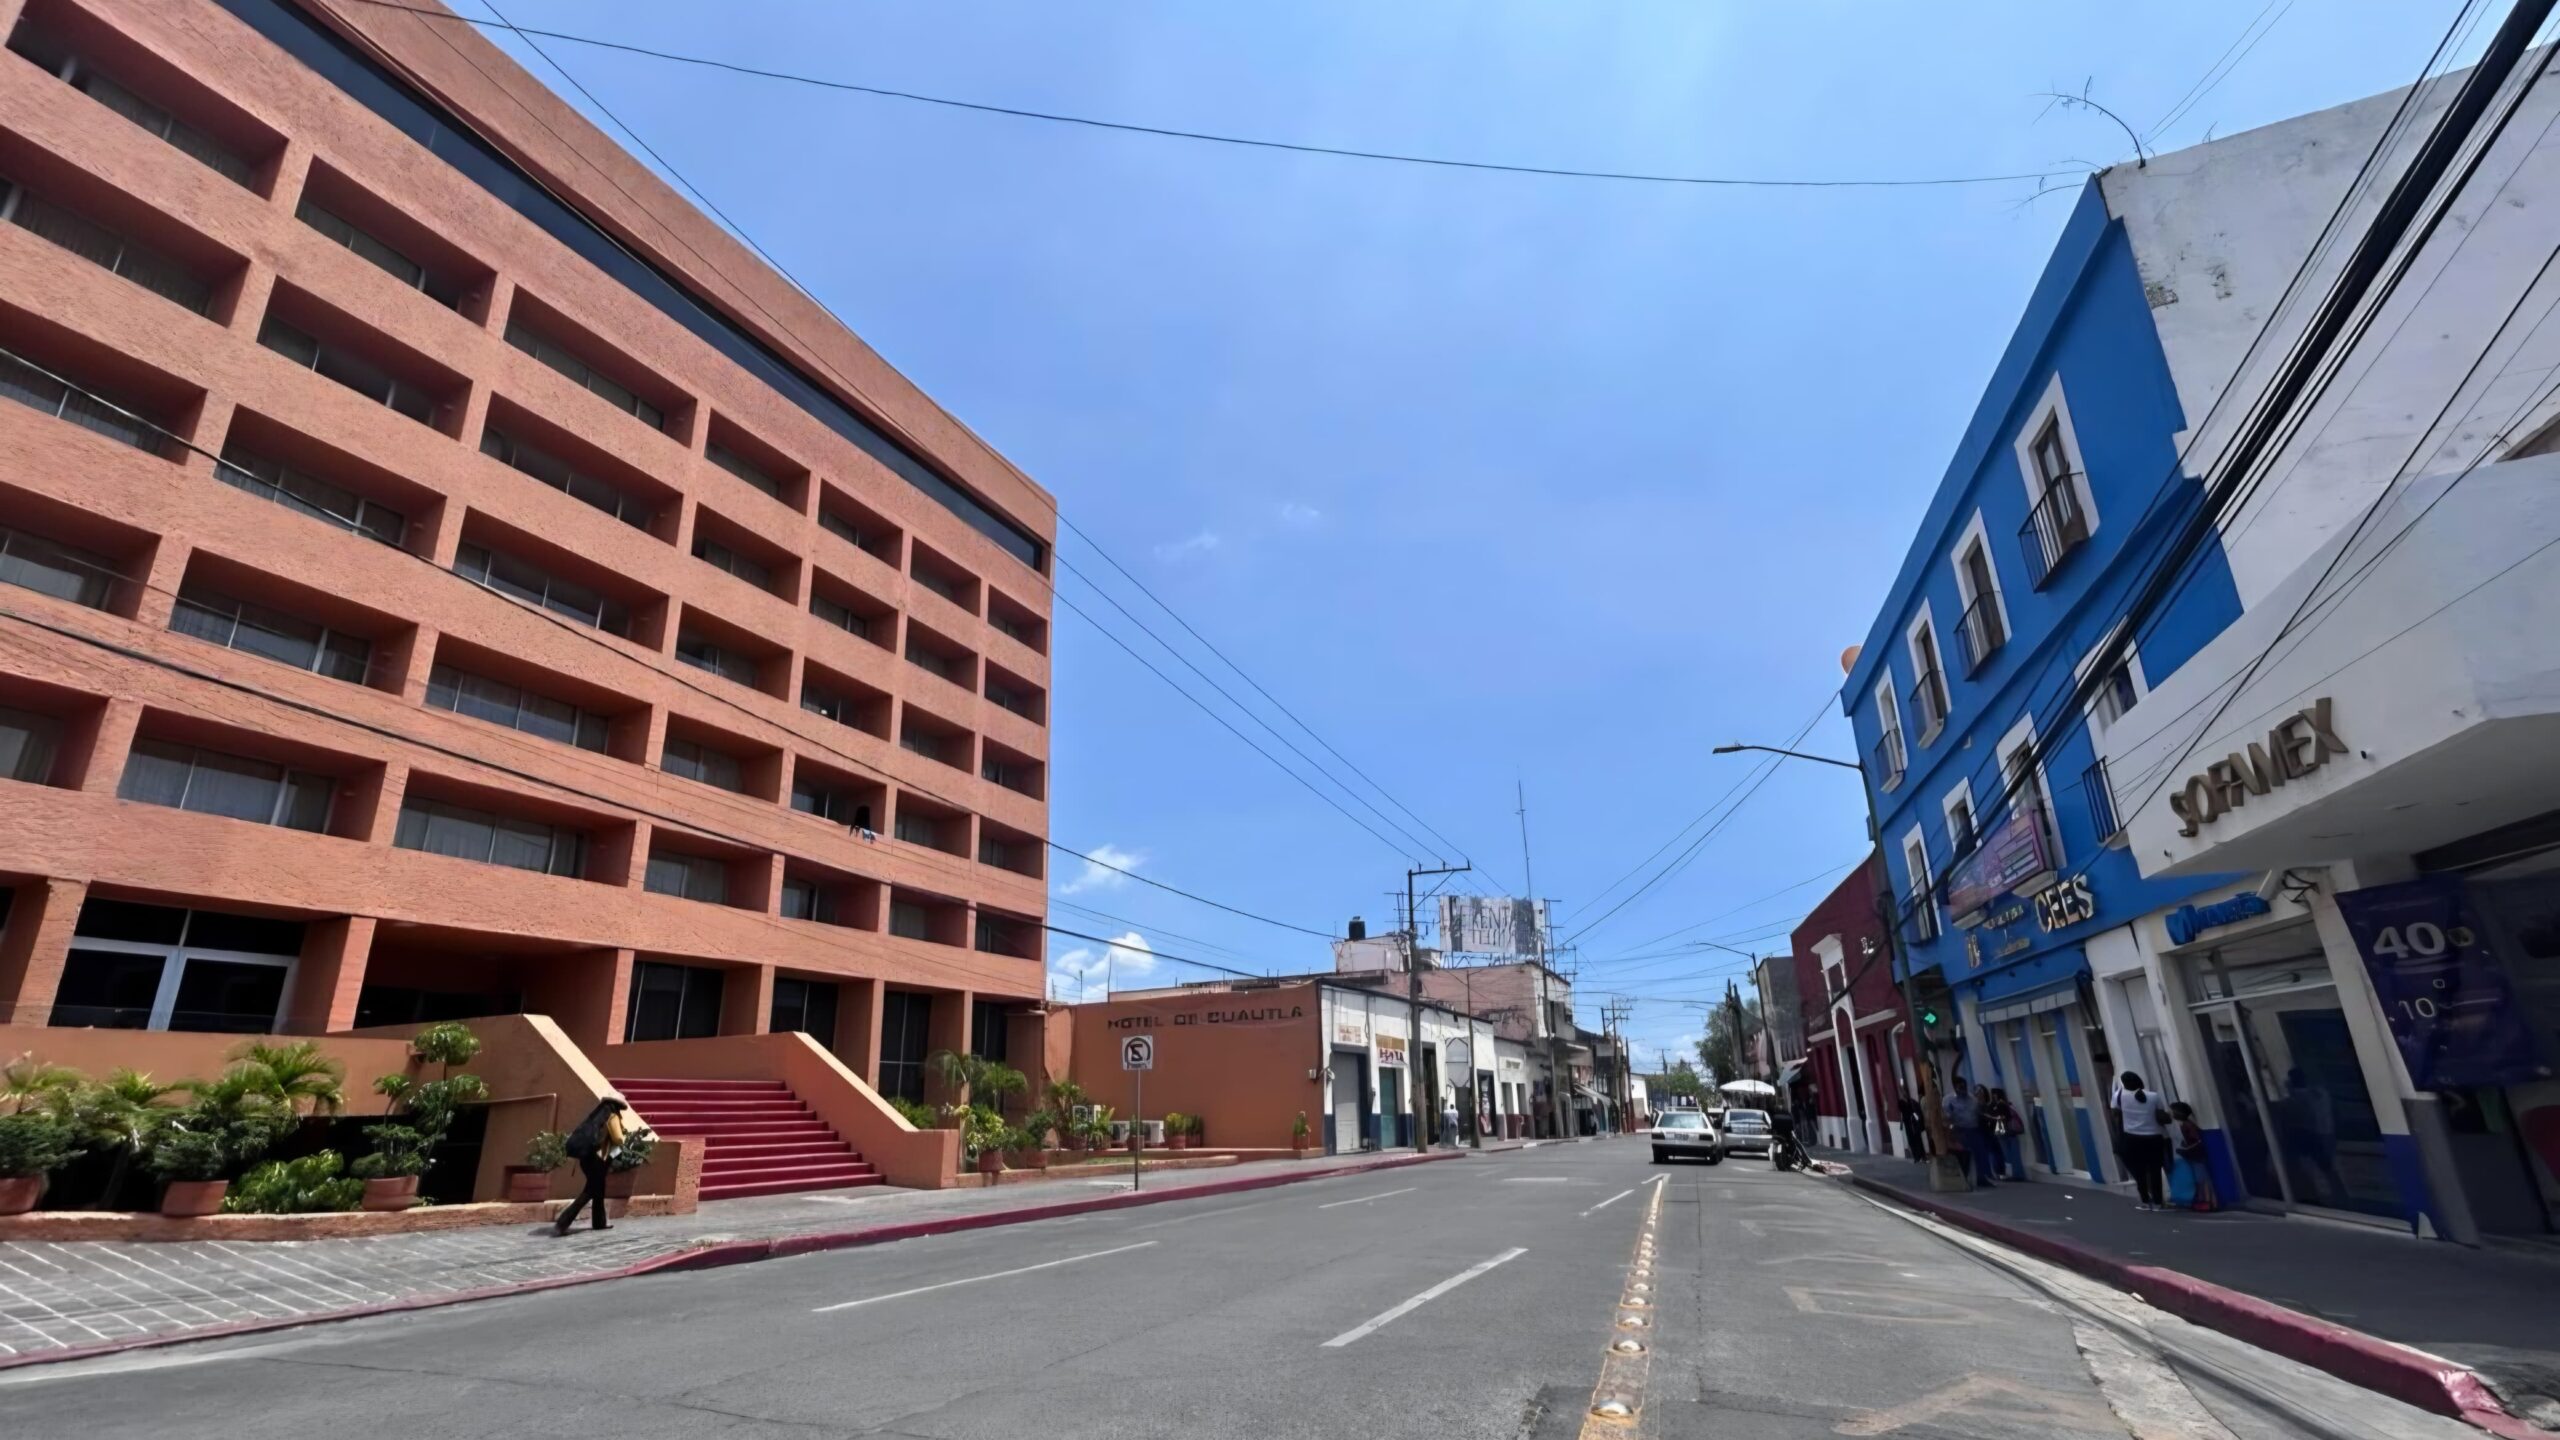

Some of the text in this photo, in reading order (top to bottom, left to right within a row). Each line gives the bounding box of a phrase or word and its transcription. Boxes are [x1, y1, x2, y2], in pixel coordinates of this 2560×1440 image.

[2170, 697, 2349, 837] SOFAMEX
[1107, 1015, 1164, 1030] HOTEL
[1207, 1005, 1303, 1024] CUAUTLA
